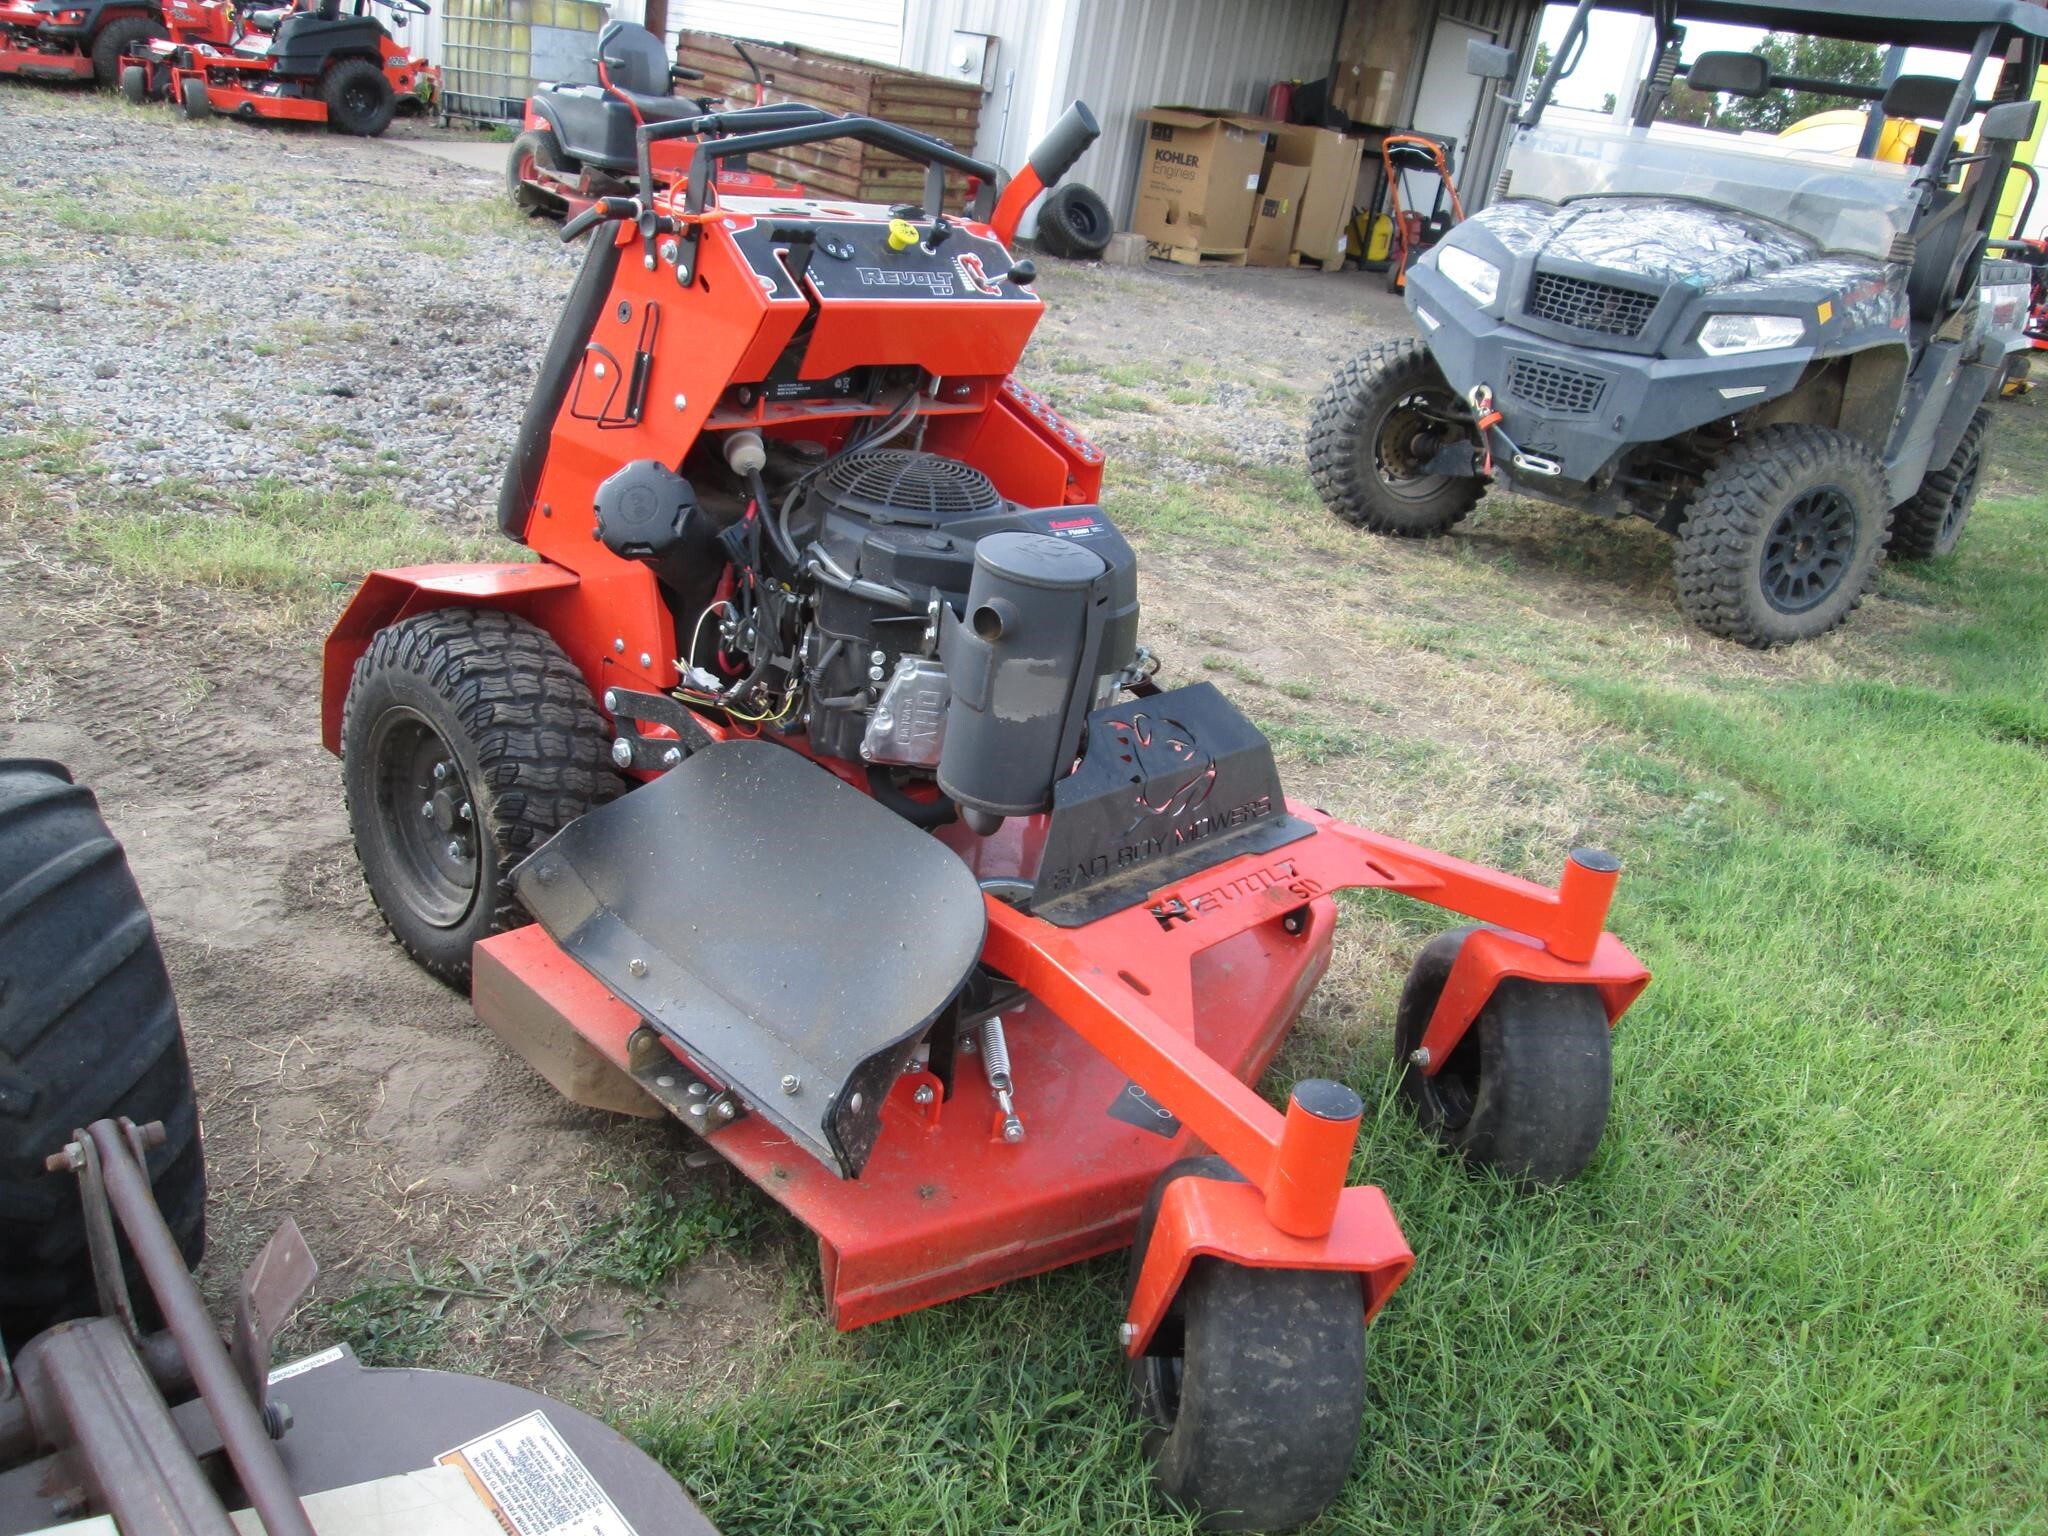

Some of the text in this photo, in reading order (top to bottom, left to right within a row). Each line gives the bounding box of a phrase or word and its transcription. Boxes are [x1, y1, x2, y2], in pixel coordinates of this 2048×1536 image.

[1155, 148, 1199, 168] KOHLER
[1152, 161, 1195, 180] Engines
[856, 267, 953, 285] REVOLT
[1054, 795, 1272, 891] BAD BOY MOWERS
[470, 1455, 493, 1480] FOLLOW
[495, 1490, 519, 1516] FAILURE
